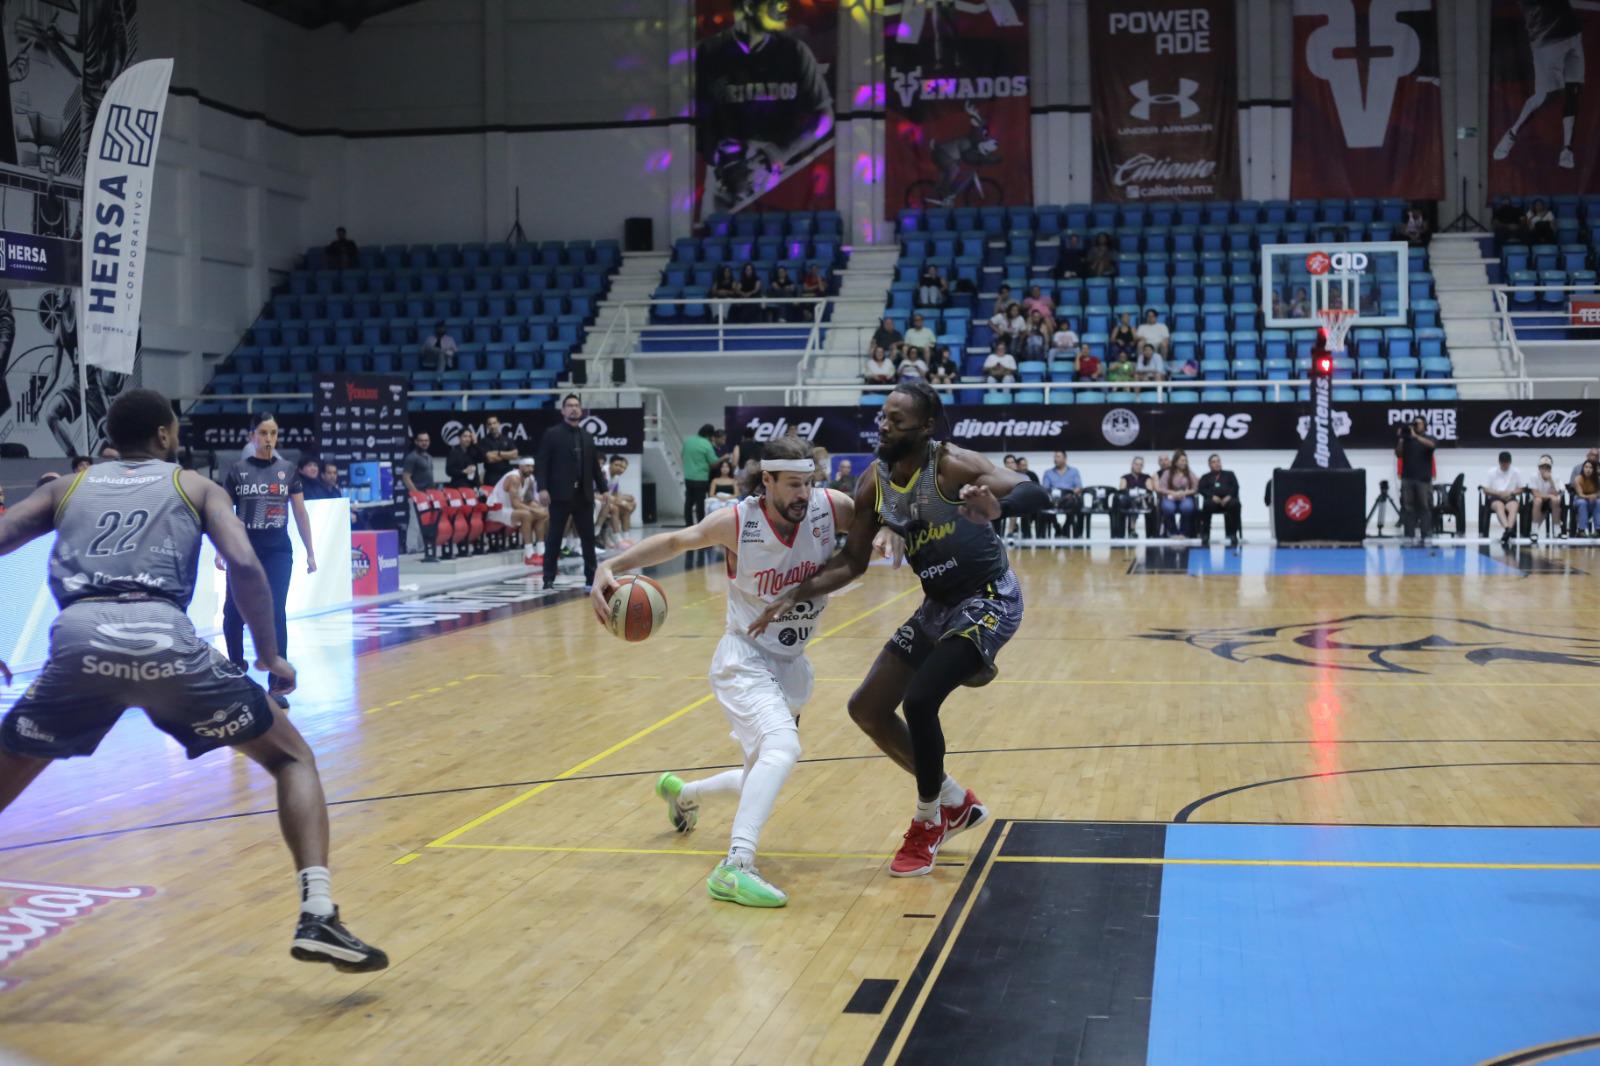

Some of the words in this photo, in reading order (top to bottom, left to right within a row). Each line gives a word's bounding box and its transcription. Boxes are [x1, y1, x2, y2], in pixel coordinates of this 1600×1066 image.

[1109, 8, 1210, 35] POWER
[1156, 31, 1211, 55] ADE
[891, 66, 1028, 107] VENADOS
[1118, 125, 1159, 136] UNDER
[1161, 123, 1213, 134] ARMOUR
[1114, 153, 1216, 186] Caliente
[8, 244, 47, 264] HERSA
[88, 175, 128, 314] HERSA
[126, 191, 143, 300] CORPORATIVO
[746, 417, 824, 442] telel
[953, 418, 1064, 438] dportenis
[1184, 413, 1252, 440] ms
[1314, 377, 1330, 468] dportenis
[1388, 409, 1457, 426] POWER
[1490, 410, 1582, 438] Coca-Cola
[468, 423, 529, 441] MGA
[86, 510, 149, 557] 22
[921, 557, 958, 579] oppel
[82, 655, 186, 682] SoniGas
